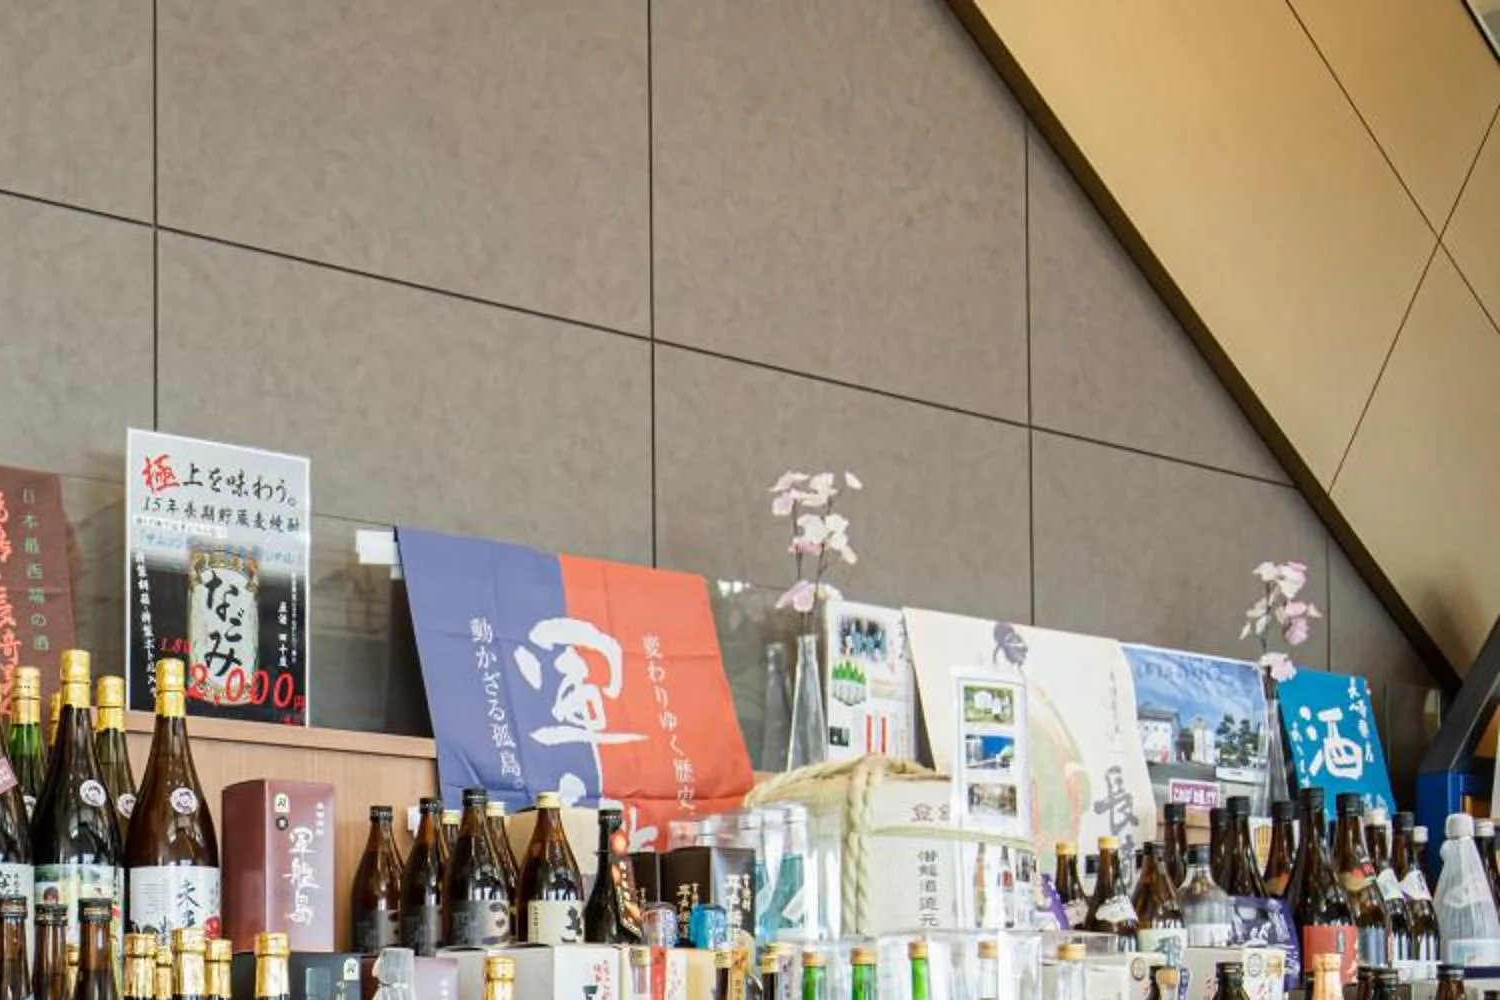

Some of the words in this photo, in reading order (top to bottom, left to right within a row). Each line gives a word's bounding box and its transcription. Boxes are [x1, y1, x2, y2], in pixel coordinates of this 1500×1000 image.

[141, 453, 297, 508] 極上を味わう。
[202, 568, 245, 678] なごみ
[1299, 705, 1364, 781] 酒
